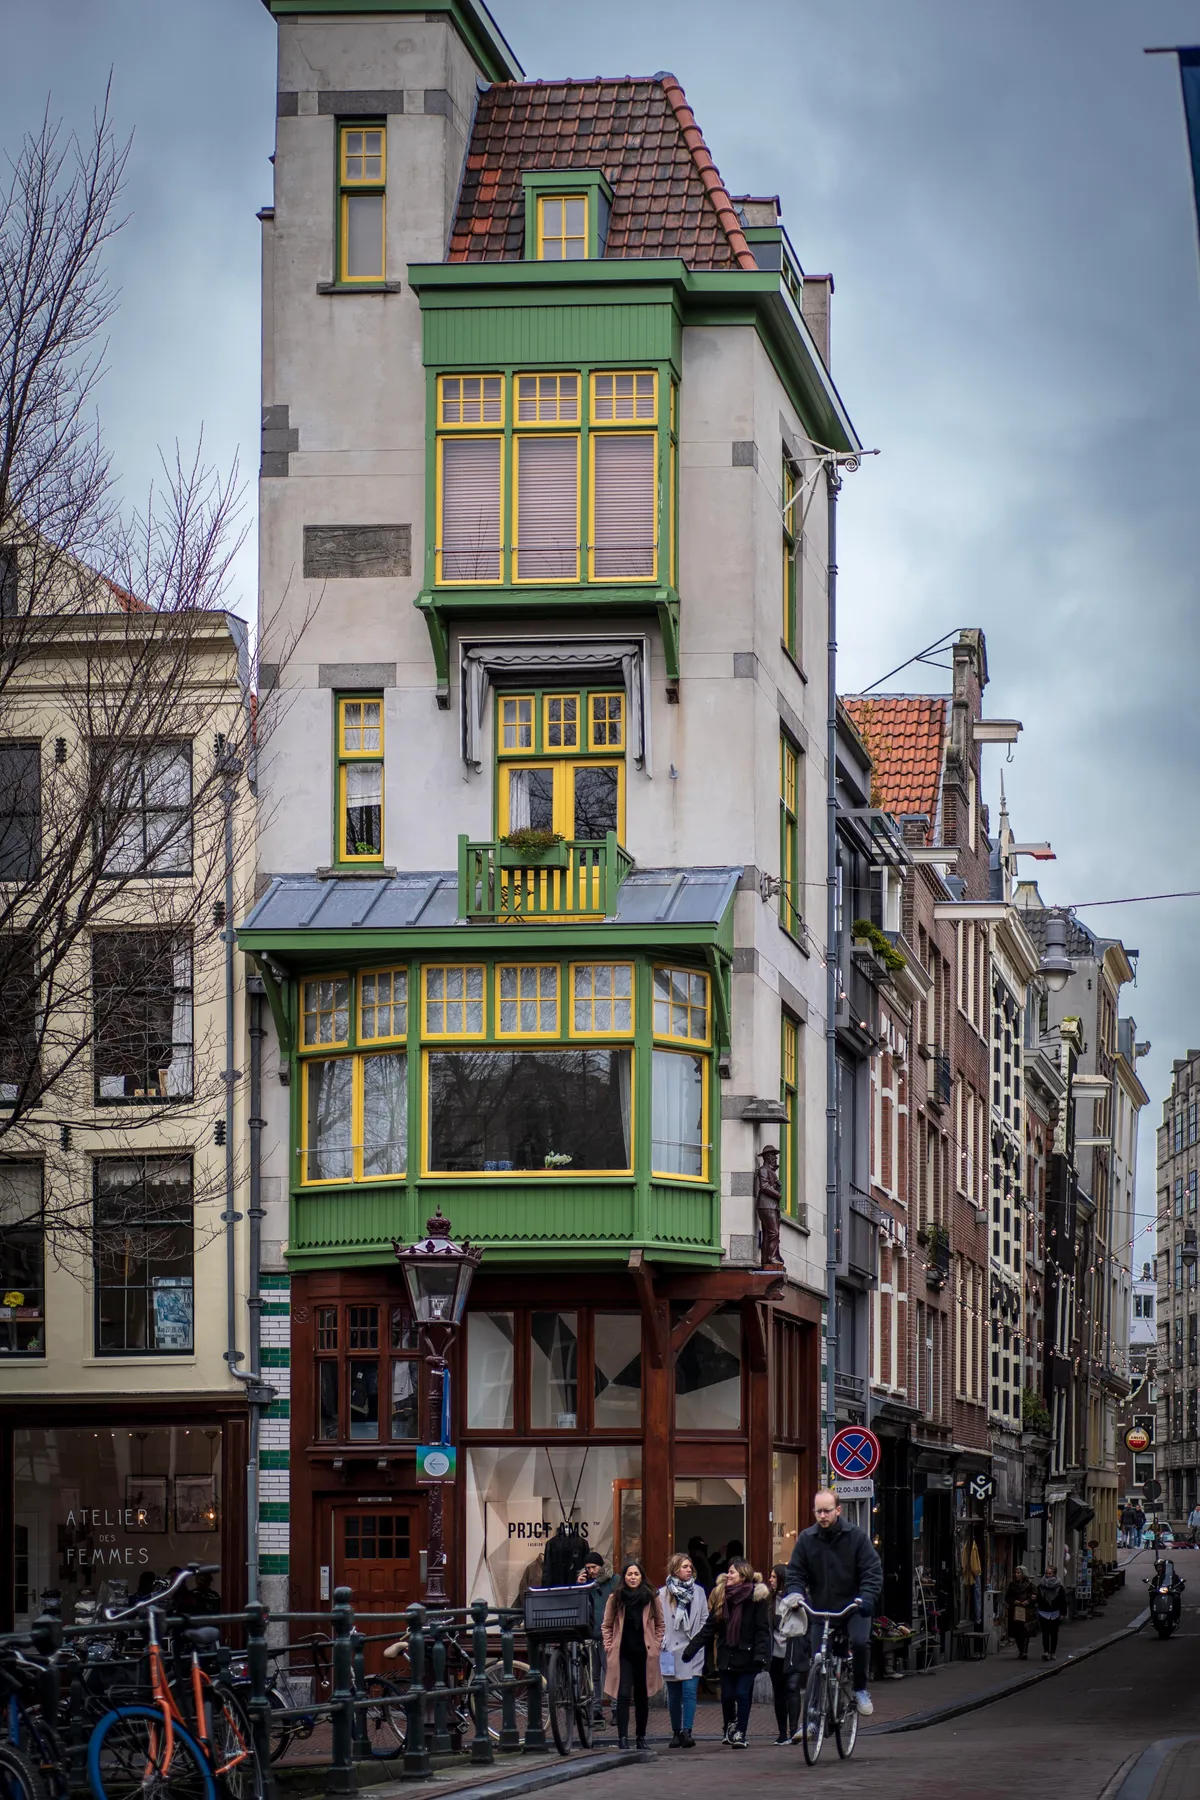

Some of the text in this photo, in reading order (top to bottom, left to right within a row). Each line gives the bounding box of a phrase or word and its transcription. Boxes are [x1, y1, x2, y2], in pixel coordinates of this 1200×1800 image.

[66, 1509, 148, 1526] ATELIER
[508, 1522, 552, 1538] PRJCT
[559, 1521, 589, 1538] AMS
[99, 1534, 116, 1543] DES
[67, 1548, 149, 1565] FEMMES
